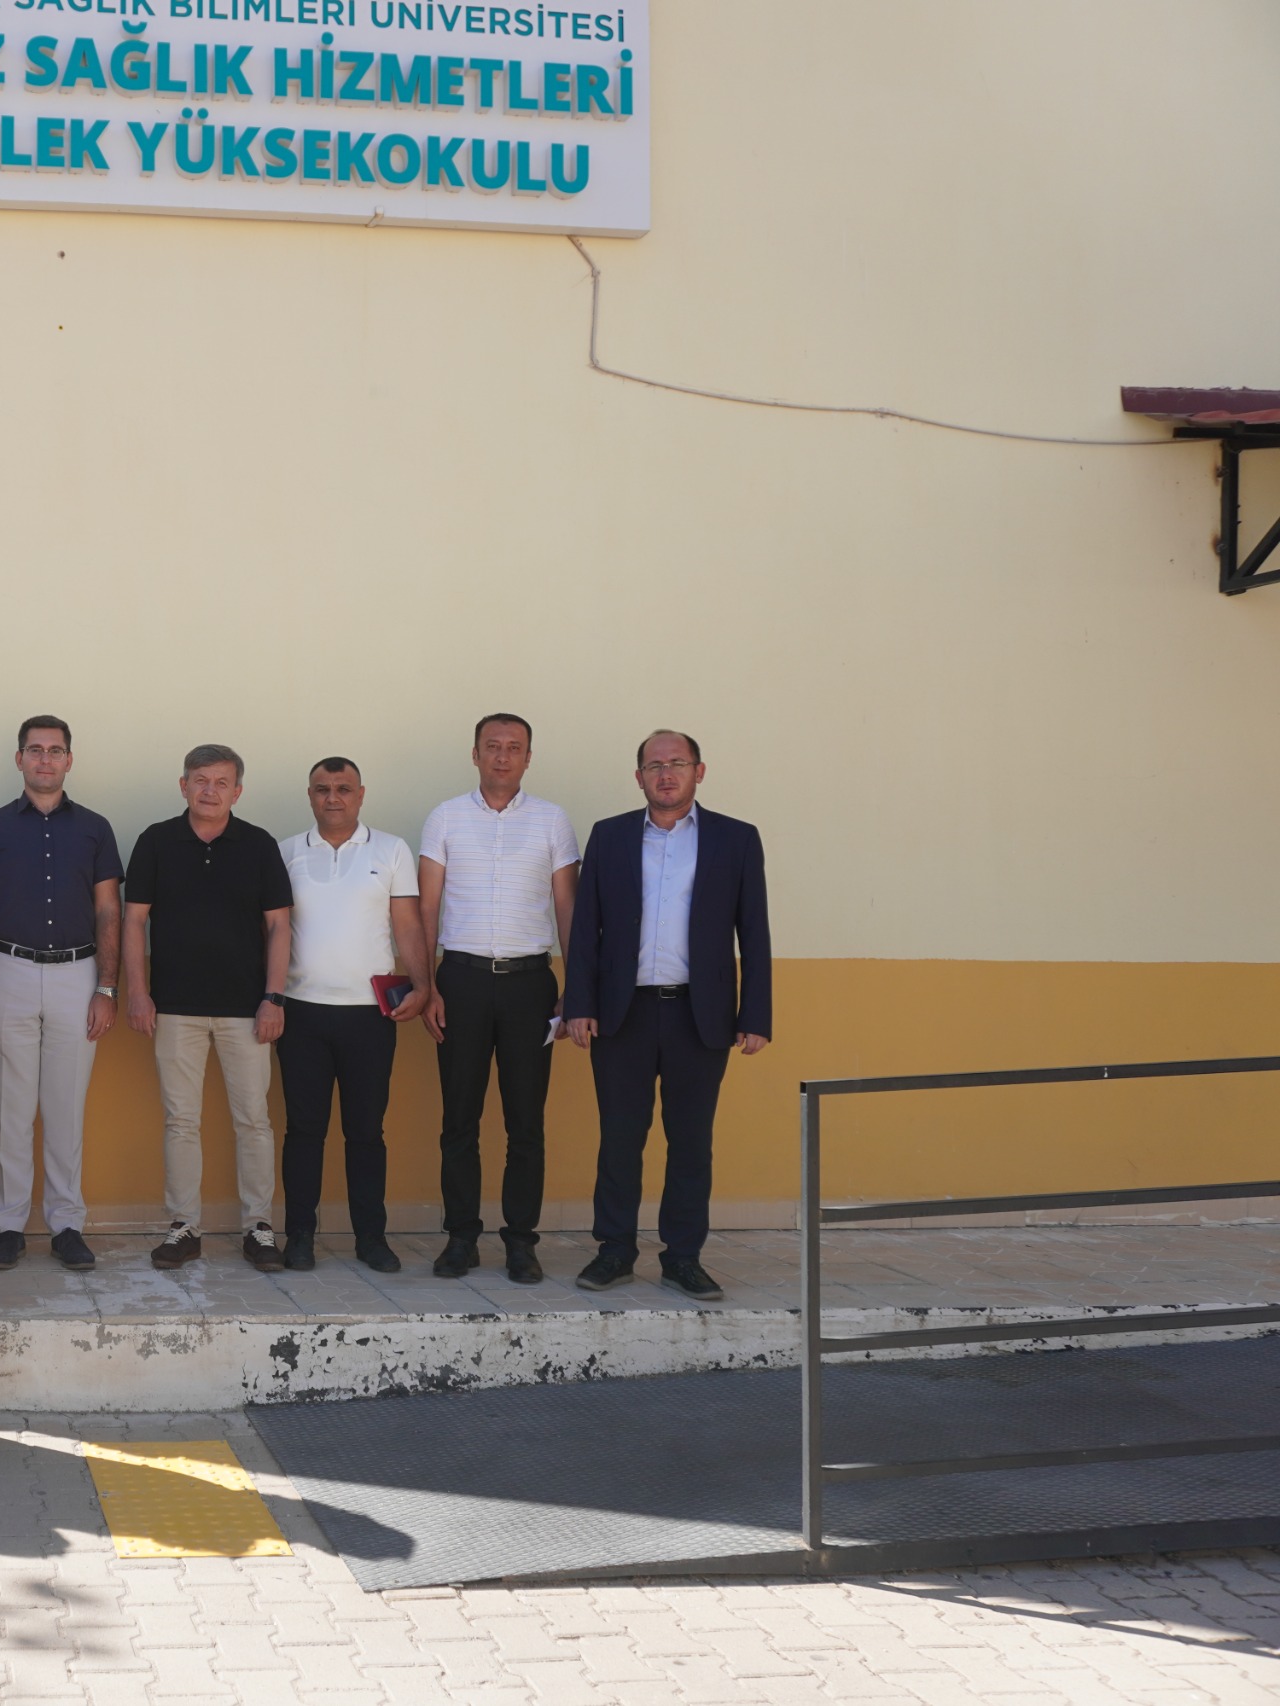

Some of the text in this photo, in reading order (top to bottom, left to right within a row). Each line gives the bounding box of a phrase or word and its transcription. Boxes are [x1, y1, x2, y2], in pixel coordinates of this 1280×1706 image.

[25, 19, 253, 96] SAĞLIK
[273, 31, 634, 117] HİZMETLERİ
[126, 107, 590, 195] YÜKSEKOKULU
